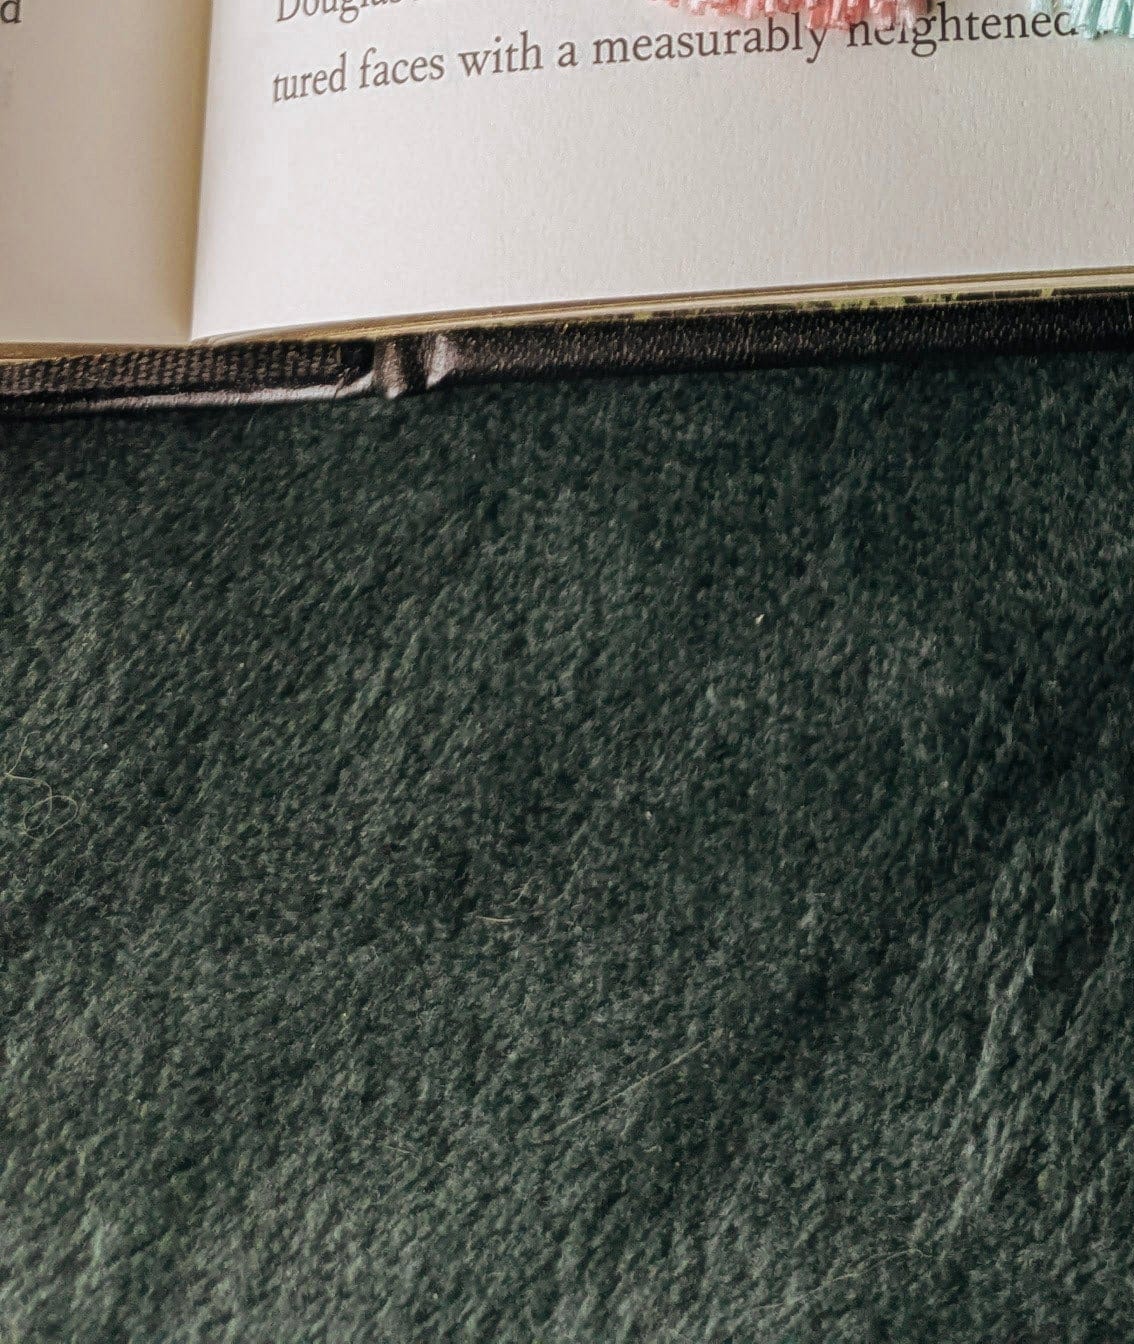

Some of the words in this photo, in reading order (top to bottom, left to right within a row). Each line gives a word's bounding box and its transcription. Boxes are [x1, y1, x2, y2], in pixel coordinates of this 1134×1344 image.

[273, 51, 347, 103] tured
[359, 47, 445, 89] faces
[457, 30, 544, 77] with
[592, 12, 829, 65] measurably
